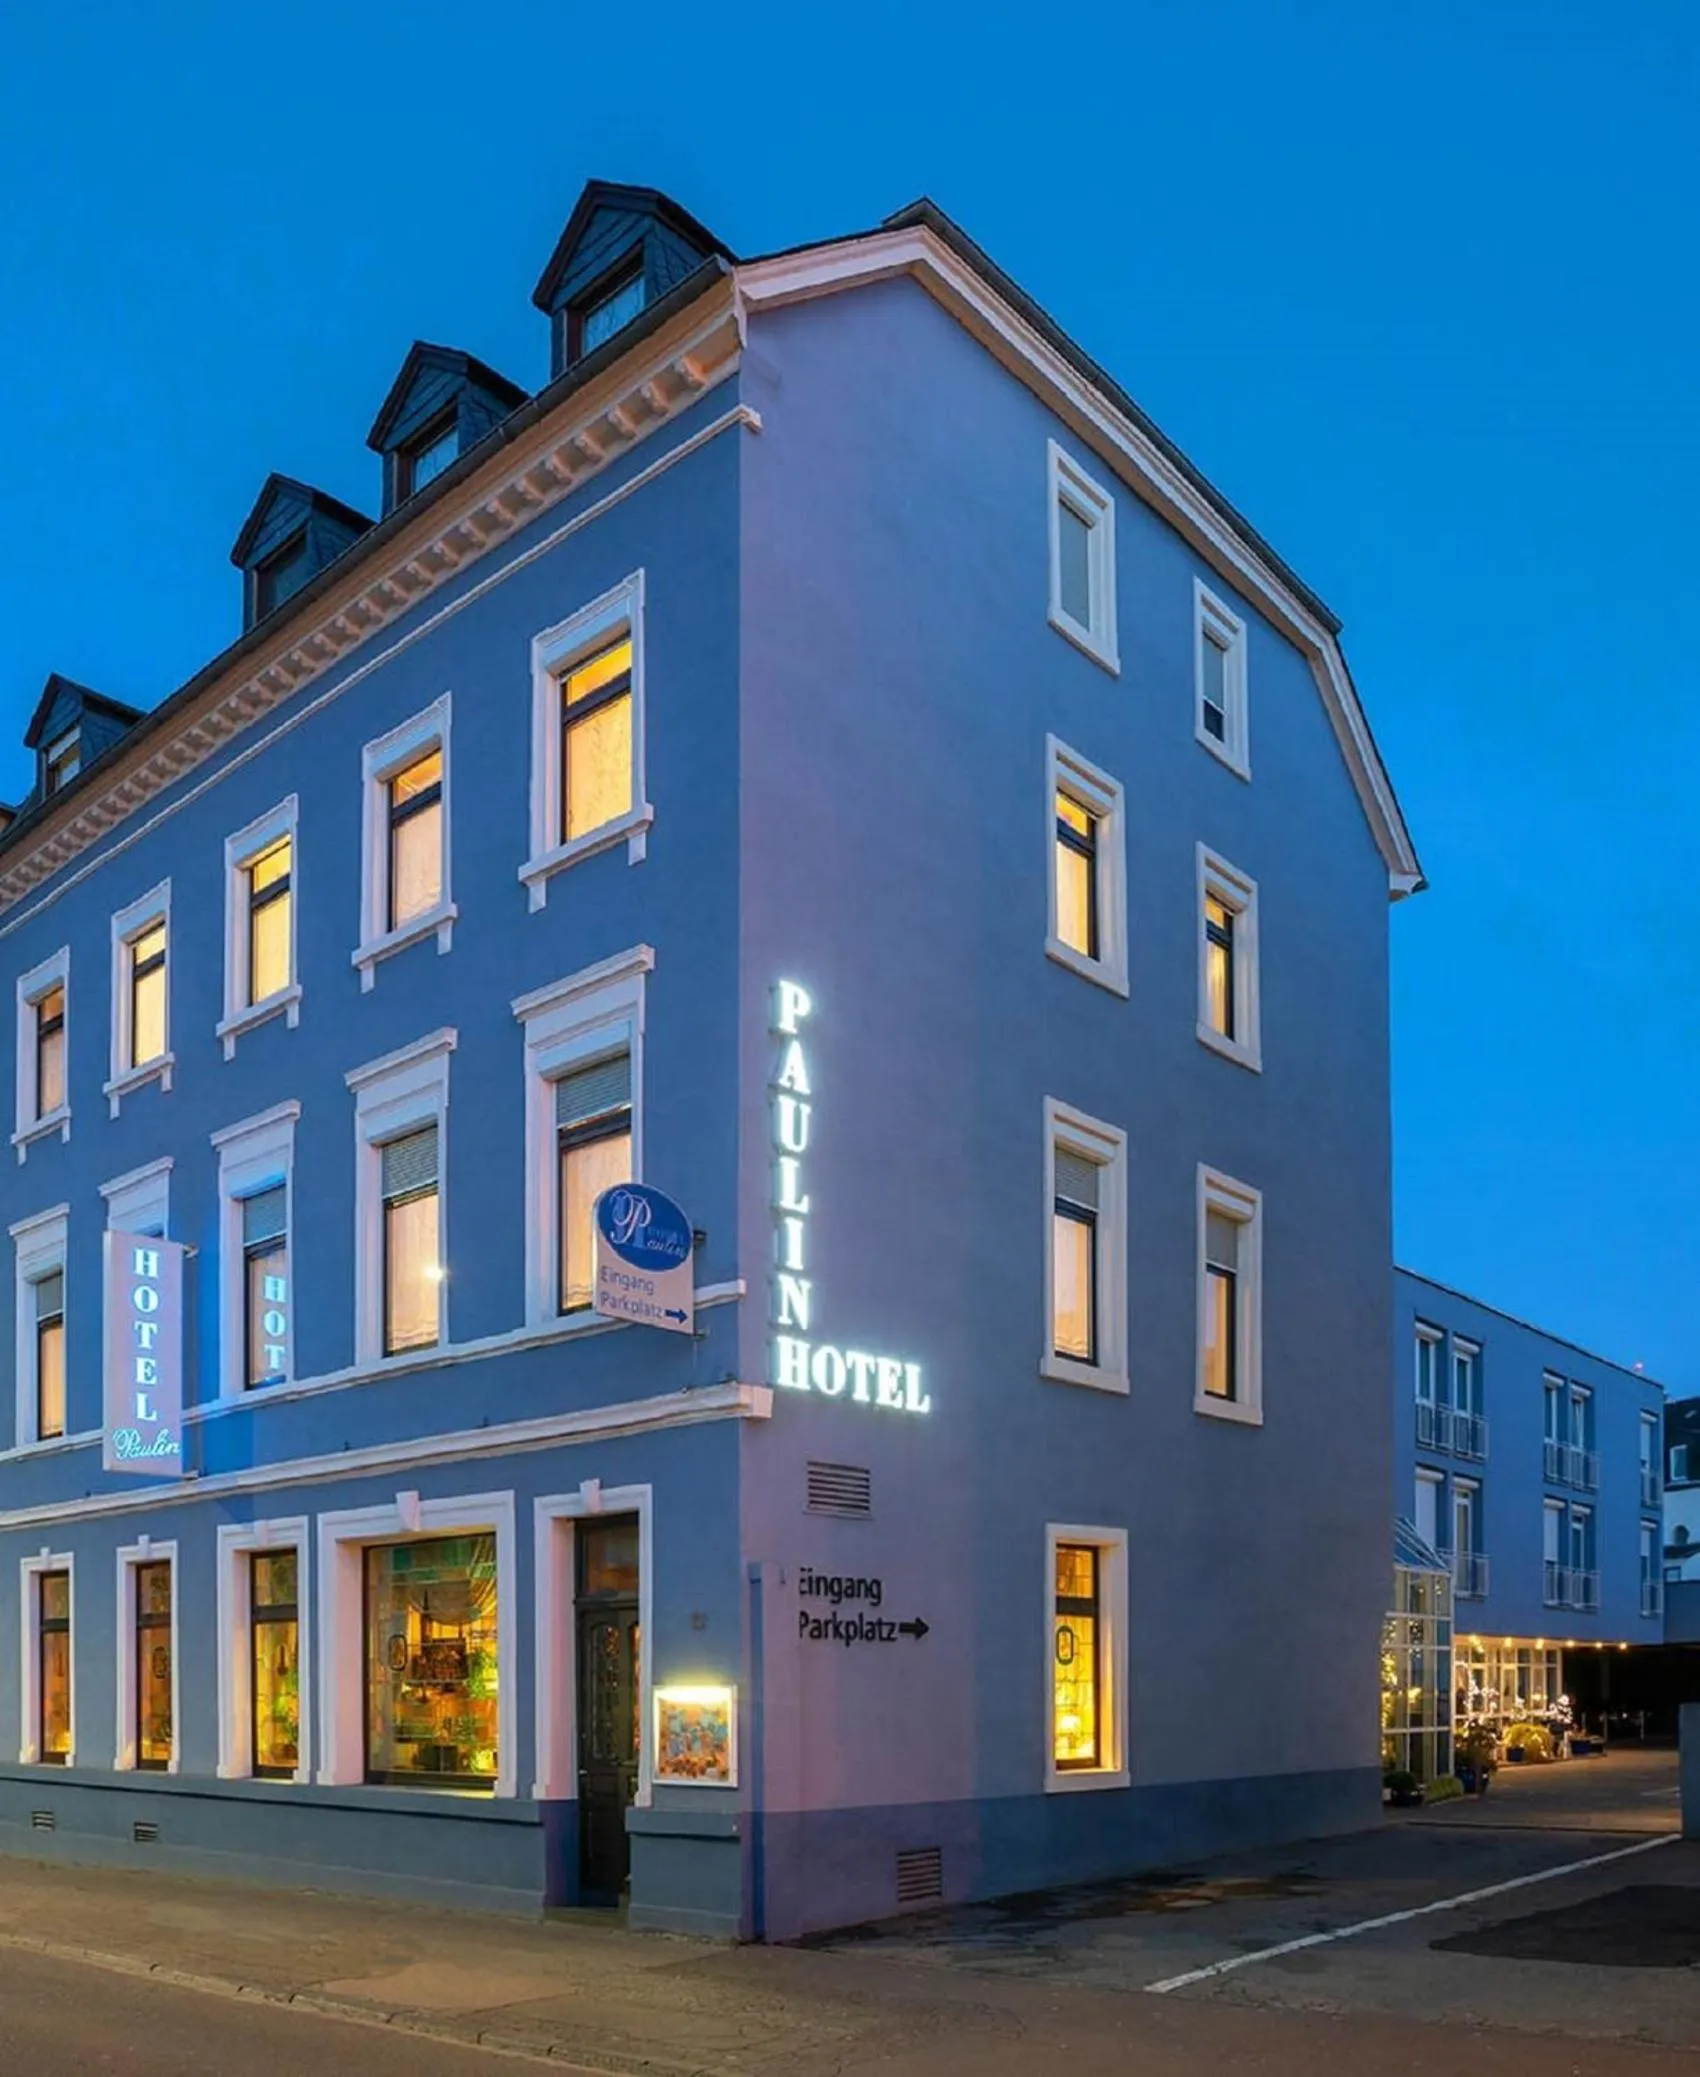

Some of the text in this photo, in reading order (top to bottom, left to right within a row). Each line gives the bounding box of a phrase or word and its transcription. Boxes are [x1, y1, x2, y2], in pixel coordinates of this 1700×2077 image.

[778, 979, 812, 1331] PAULIN
[601, 1265, 654, 1296] Eingang
[601, 1291, 664, 1320] Parkplatz
[133, 1248, 159, 1422] HOTEL
[777, 1335, 931, 1414] HOTEL
[113, 1427, 181, 1461] Paulin
[798, 1566, 883, 1607] Eingang
[798, 1610, 899, 1648] Parkplatz
